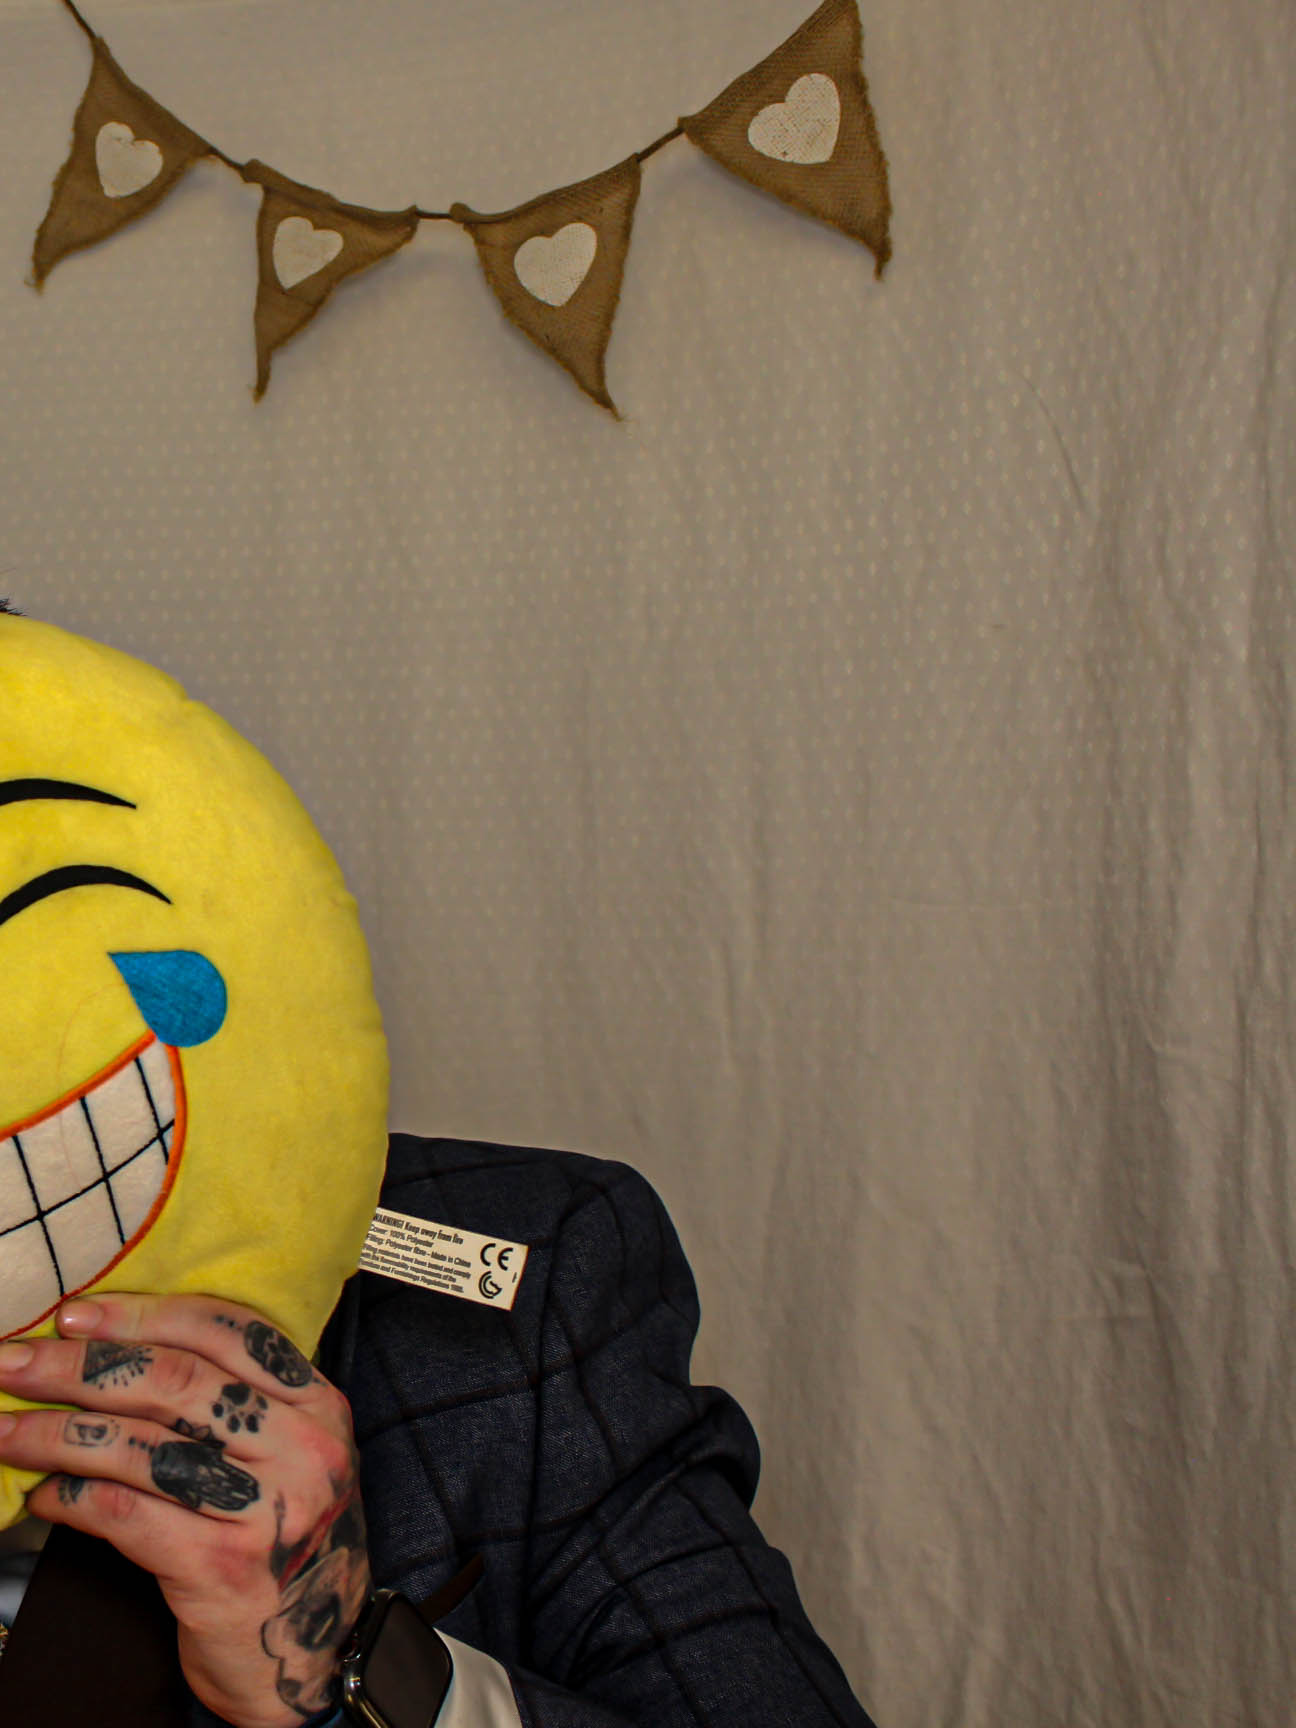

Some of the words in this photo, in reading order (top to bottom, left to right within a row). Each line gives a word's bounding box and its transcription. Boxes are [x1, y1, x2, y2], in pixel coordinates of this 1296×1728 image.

[403, 1221, 420, 1235] Keep
[419, 1228, 437, 1239] away
[437, 1229, 452, 1241] from
[452, 1233, 464, 1244] fire
[453, 1256, 471, 1268] China
[480, 1243, 514, 1271] CE
